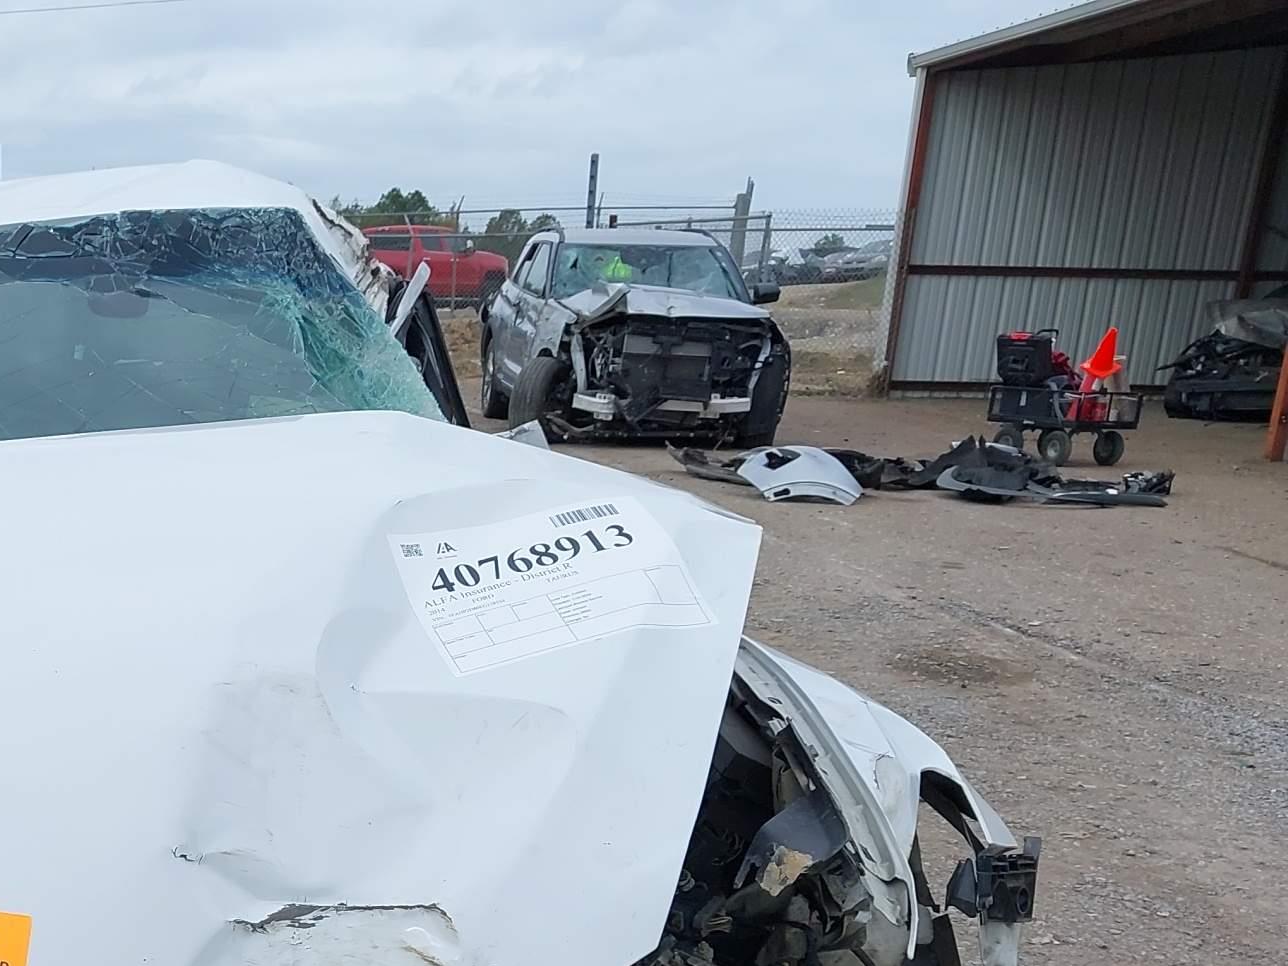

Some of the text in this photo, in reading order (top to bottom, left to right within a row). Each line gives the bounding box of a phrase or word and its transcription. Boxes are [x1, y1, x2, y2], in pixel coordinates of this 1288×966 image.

[431, 523, 634, 593] 40768913
[424, 594, 458, 609] ALFA
[461, 579, 512, 599] Insurance
[521, 566, 562, 583] District
[563, 562, 573, 570] R
[428, 607, 446, 616] 2014
[471, 594, 495, 603] FORD
[546, 570, 580, 583] TAURUS
